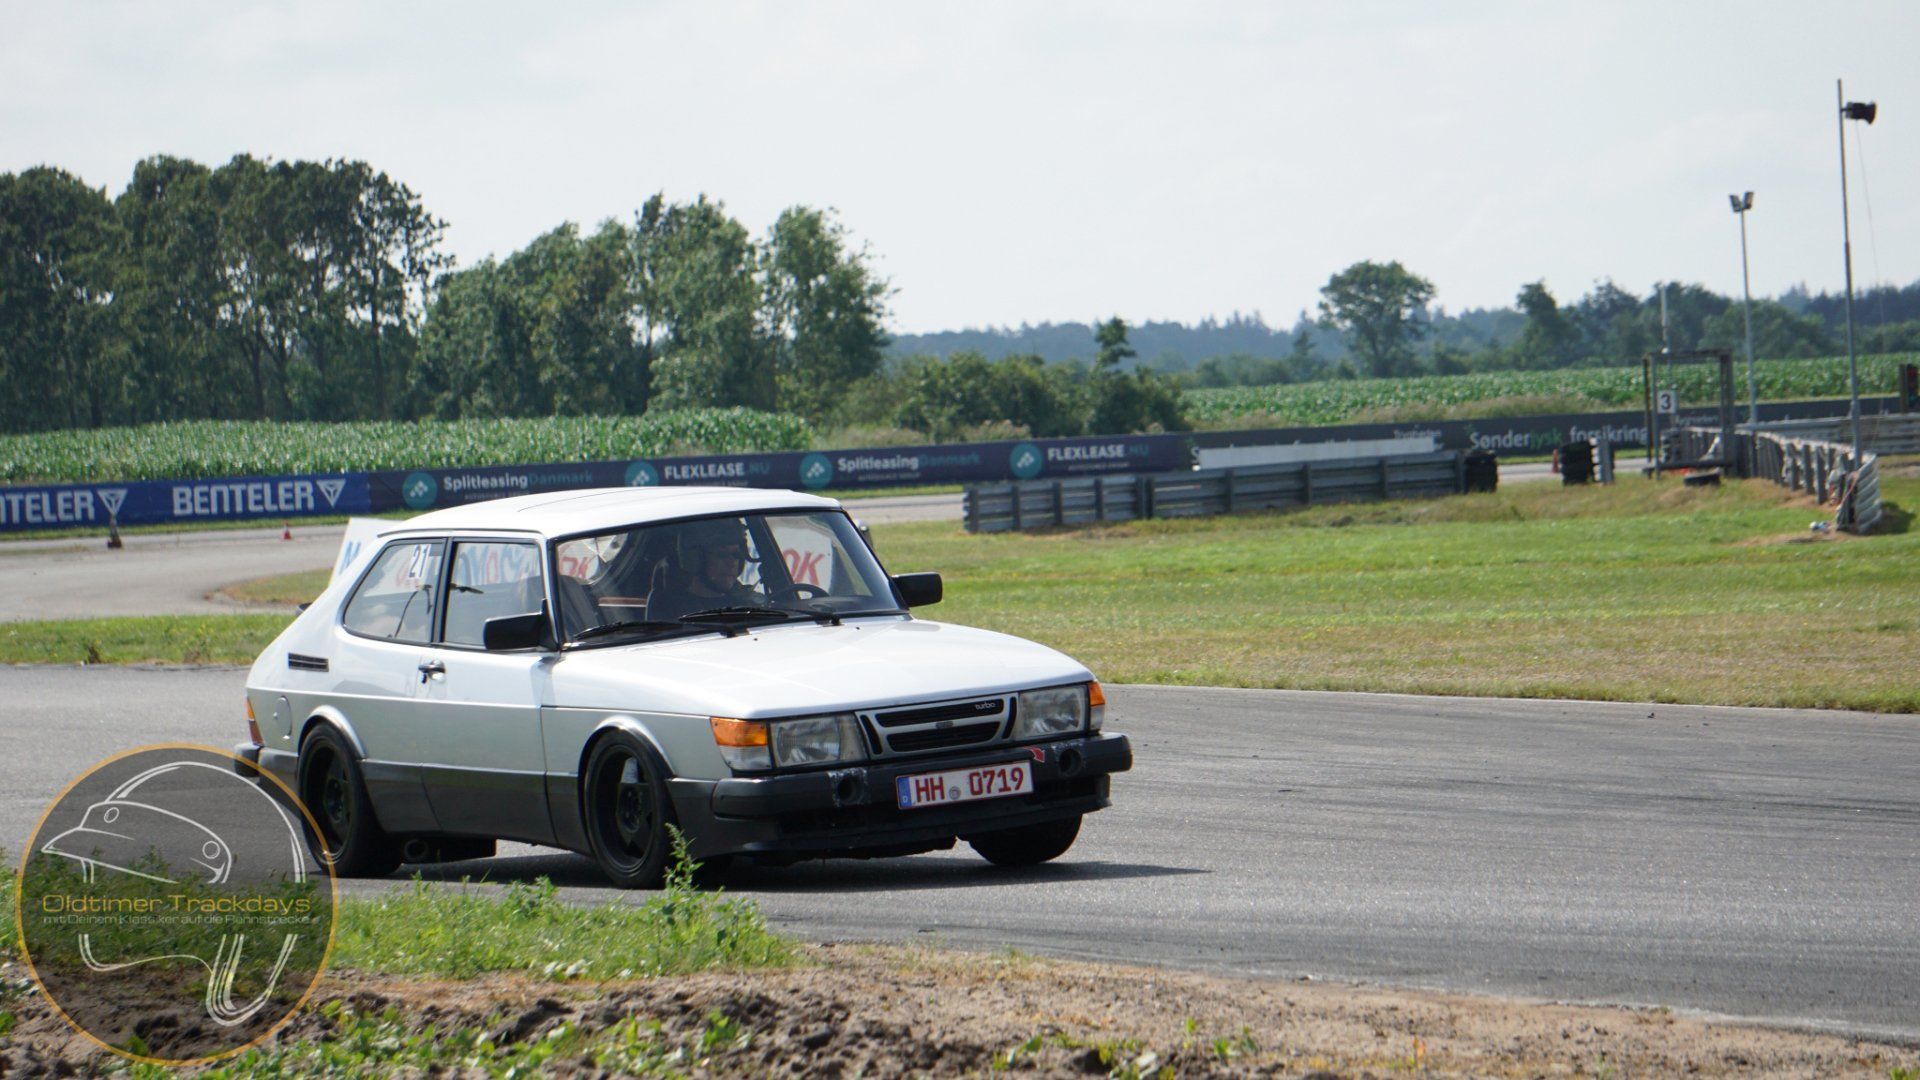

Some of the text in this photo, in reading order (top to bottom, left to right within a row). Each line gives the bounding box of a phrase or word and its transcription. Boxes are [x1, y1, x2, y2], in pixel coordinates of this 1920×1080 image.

[1660, 393, 1671, 411] 3
[172, 481, 315, 516] BENTELER
[408, 544, 430, 578] 21
[975, 701, 996, 710] turbo
[915, 776, 945, 803] HH
[968, 767, 1024, 796] 0719
